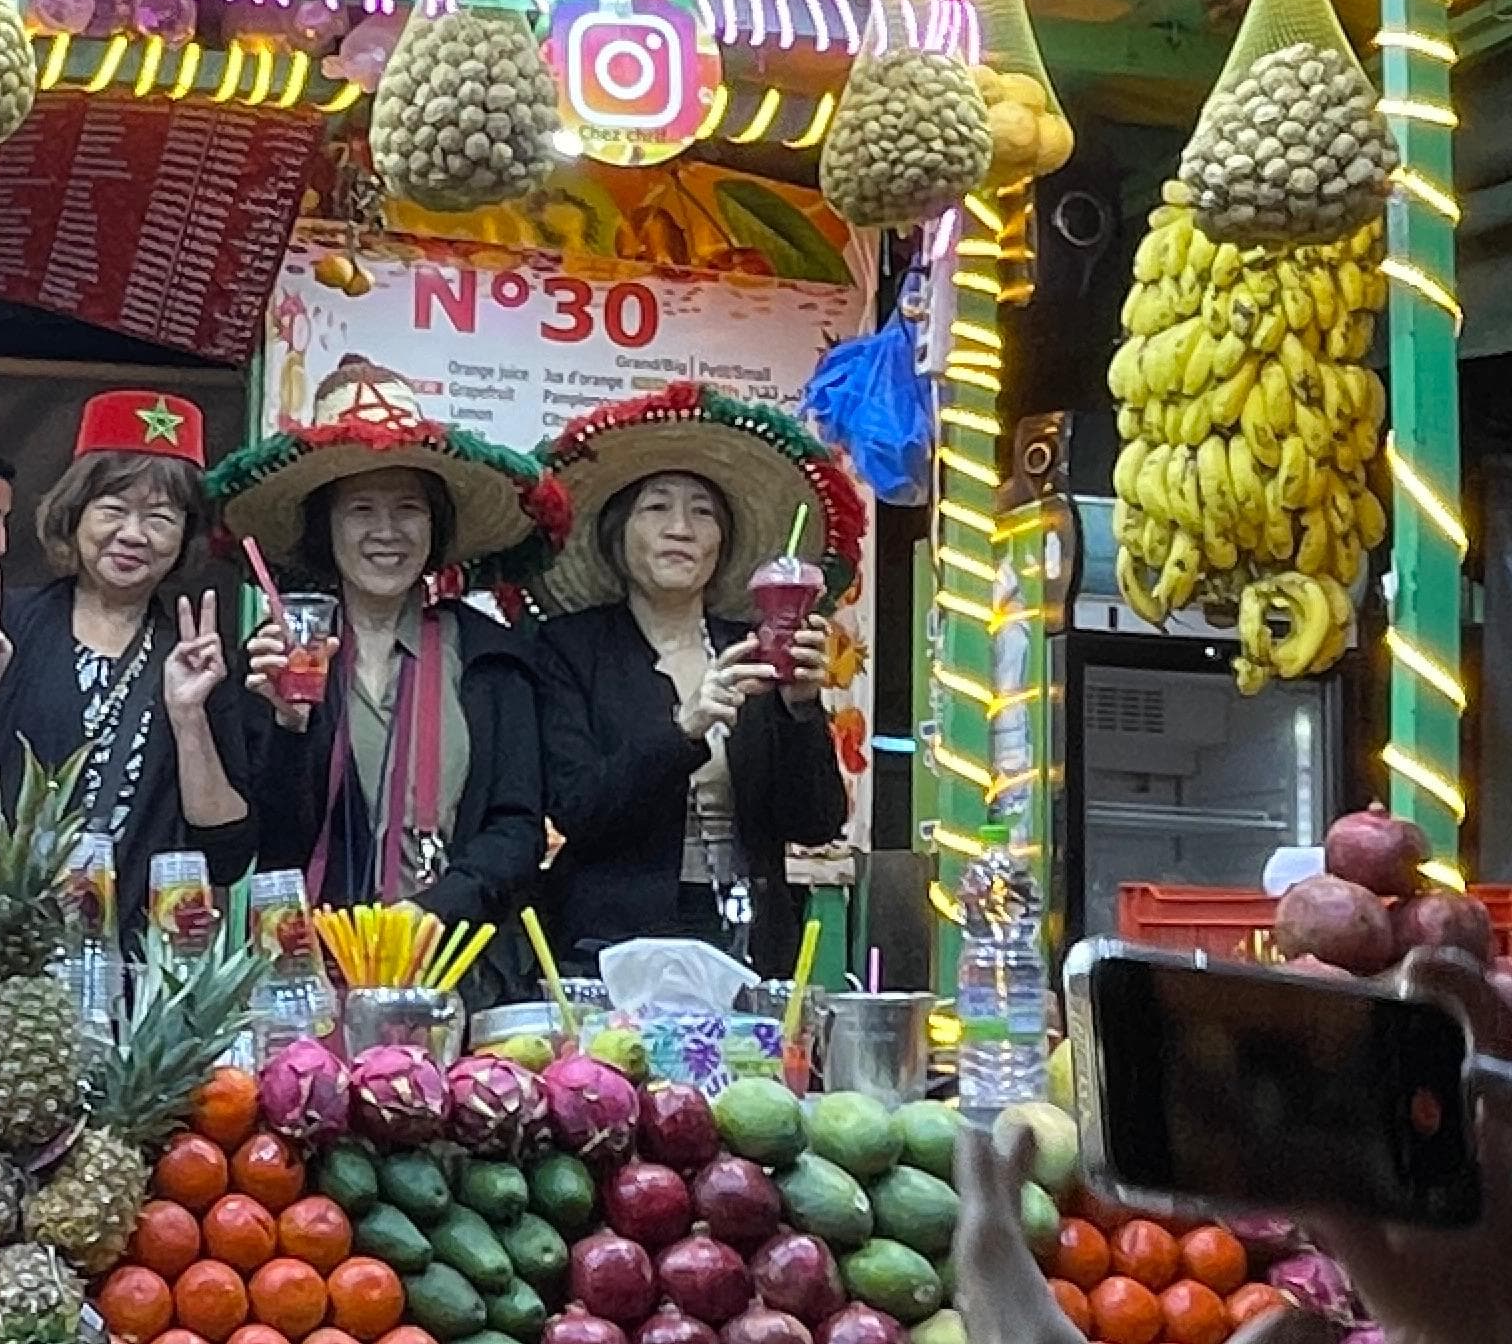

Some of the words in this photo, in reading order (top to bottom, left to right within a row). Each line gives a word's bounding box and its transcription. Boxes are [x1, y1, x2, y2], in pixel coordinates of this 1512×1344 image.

[414, 269, 658, 348] N°30
[449, 360, 494, 380] Orange
[449, 382, 516, 401] Grapefruit
